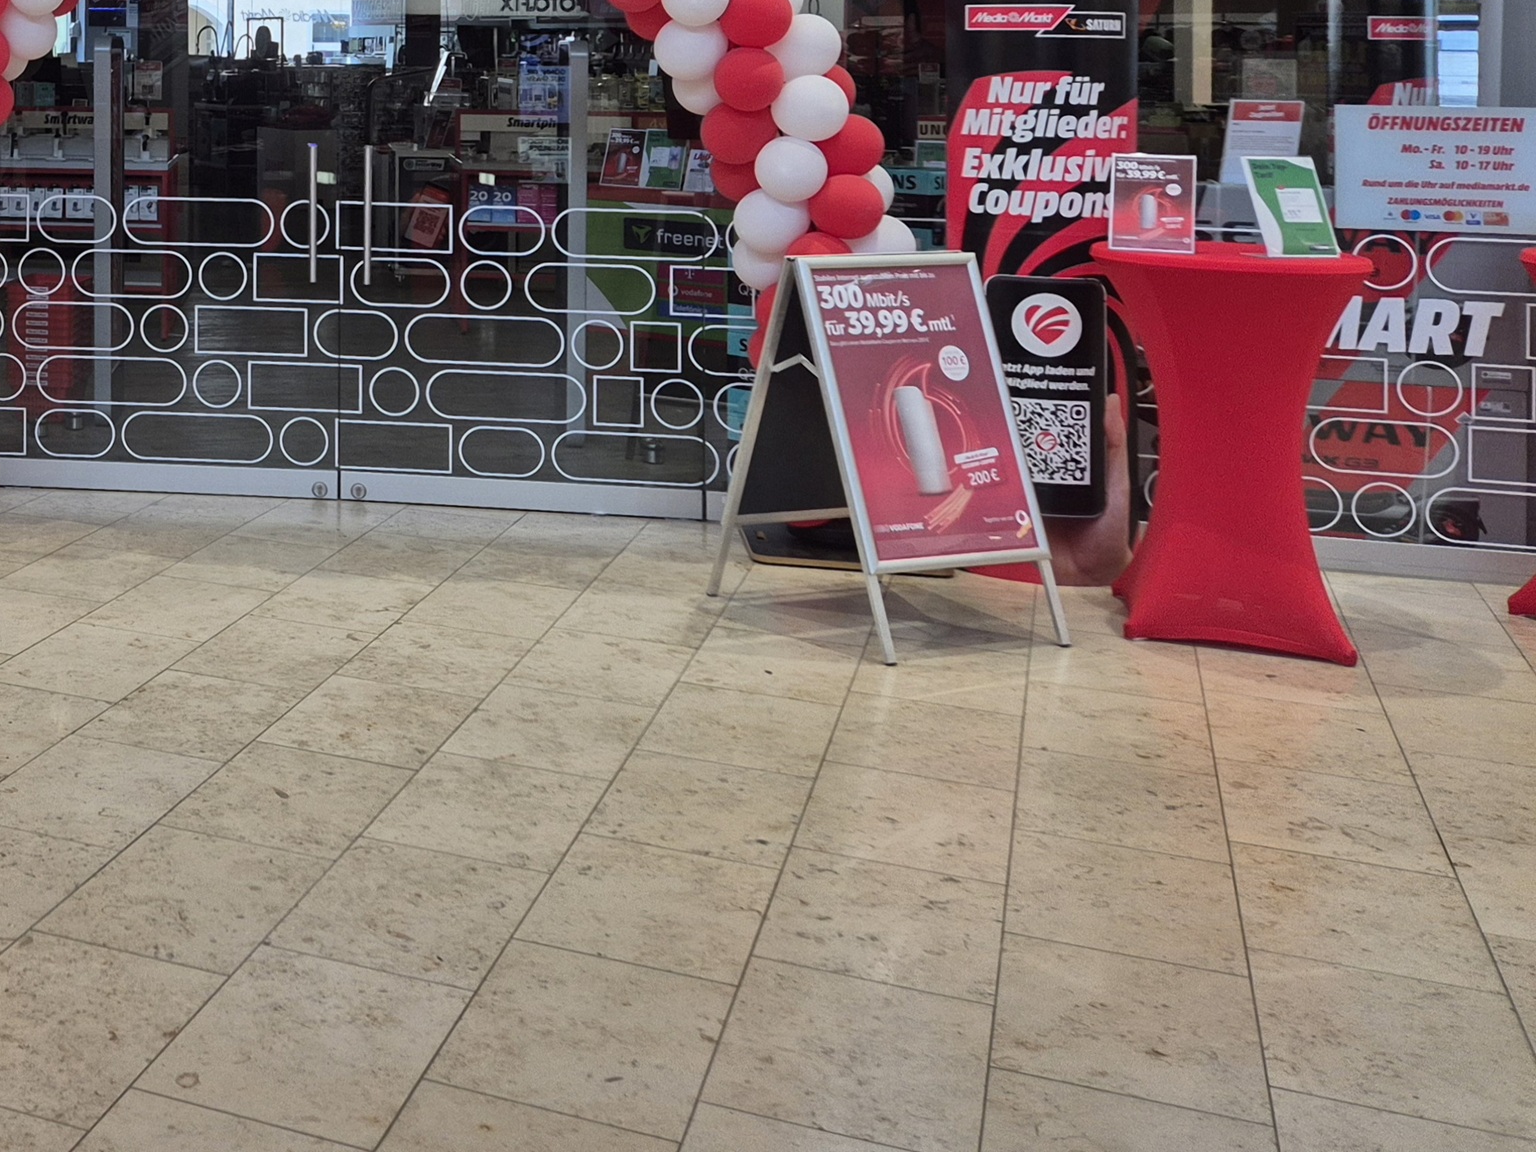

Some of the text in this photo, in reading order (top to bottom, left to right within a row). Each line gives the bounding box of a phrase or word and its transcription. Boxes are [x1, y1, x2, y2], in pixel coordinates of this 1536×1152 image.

[1085, 18, 1122, 32] SATURN
[986, 76, 1105, 106] Nur für
[43, 113, 94, 125] Smrtwa
[507, 116, 558, 130] Smartph
[960, 107, 1129, 144] Mitglieder:
[1367, 113, 1526, 134] ÖFFNUNGSZEITEN
[1454, 144, 1468, 156] 10
[1477, 145, 1491, 156] 19
[1492, 145, 1515, 157] Uhr
[961, 147, 1113, 182] Exklusiv
[1428, 159, 1446, 171] Sa.
[1455, 160, 1468, 171] 10
[1478, 160, 1491, 171] 17
[1492, 161, 1515, 172] Uhr
[1388, 181, 1404, 189] um
[1404, 180, 1419, 189] die
[1420, 180, 1438, 190] Uhr
[1438, 181, 1456, 190] auf
[1456, 181, 1531, 192] mediamarkt.de
[469, 190, 488, 202] 20
[493, 191, 512, 203] 20
[656, 228, 726, 249] freenet
[680, 288, 713, 298] vodafone
[816, 284, 911, 309] 300 Mbit/s
[824, 319, 845, 336] für
[844, 309, 909, 338] 39,99
[909, 308, 928, 333] €
[1325, 295, 1506, 358] MART
[1022, 363, 1044, 377] App
[1044, 364, 1076, 376] laden
[1075, 365, 1096, 377] und
[967, 468, 1001, 486] 200 €
